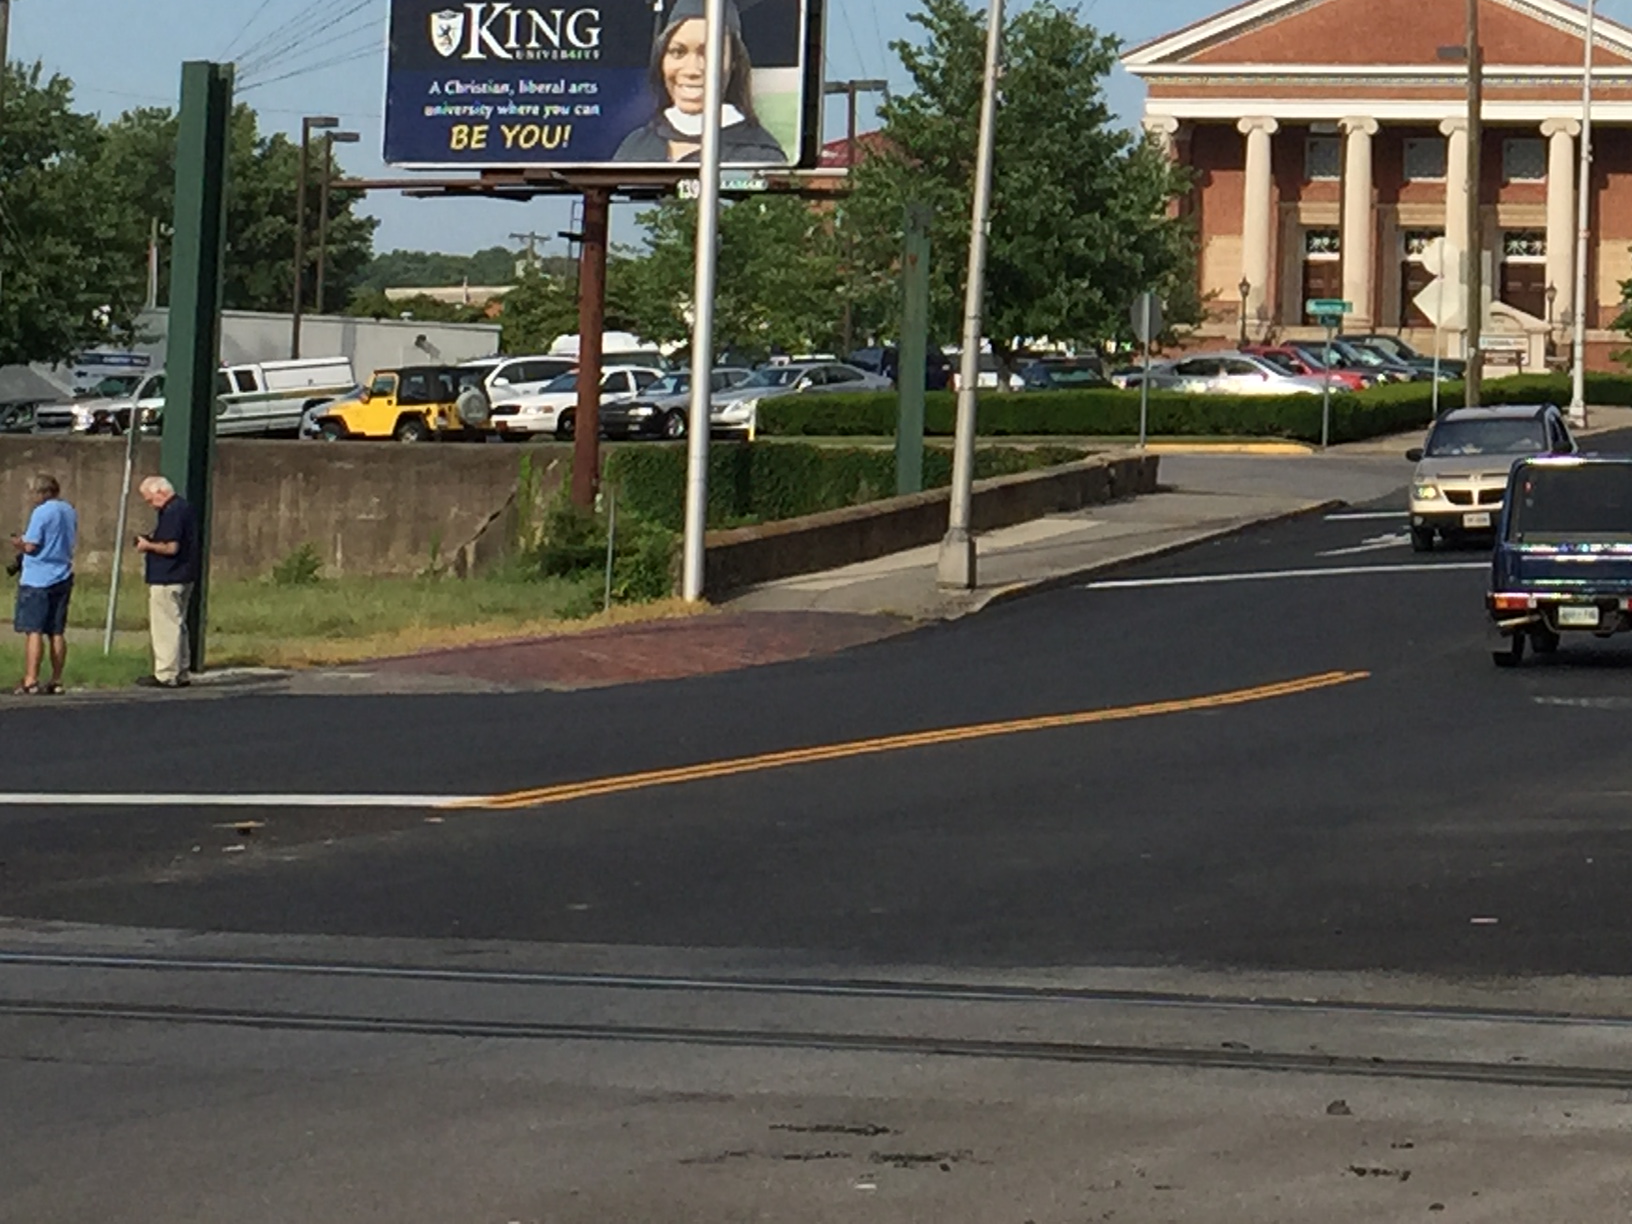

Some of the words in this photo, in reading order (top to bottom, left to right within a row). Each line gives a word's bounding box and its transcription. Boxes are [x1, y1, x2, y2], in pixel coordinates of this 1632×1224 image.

[462, 2, 602, 60] KING
[428, 81, 442, 95] A
[444, 79, 515, 96] Christian,
[519, 79, 565, 94] liberal
[568, 82, 598, 94] arts
[424, 101, 494, 120] university
[497, 99, 539, 116] where
[543, 104, 570, 120] you
[574, 104, 601, 116] can
[450, 124, 489, 150] BE
[500, 124, 572, 150] YOU!
